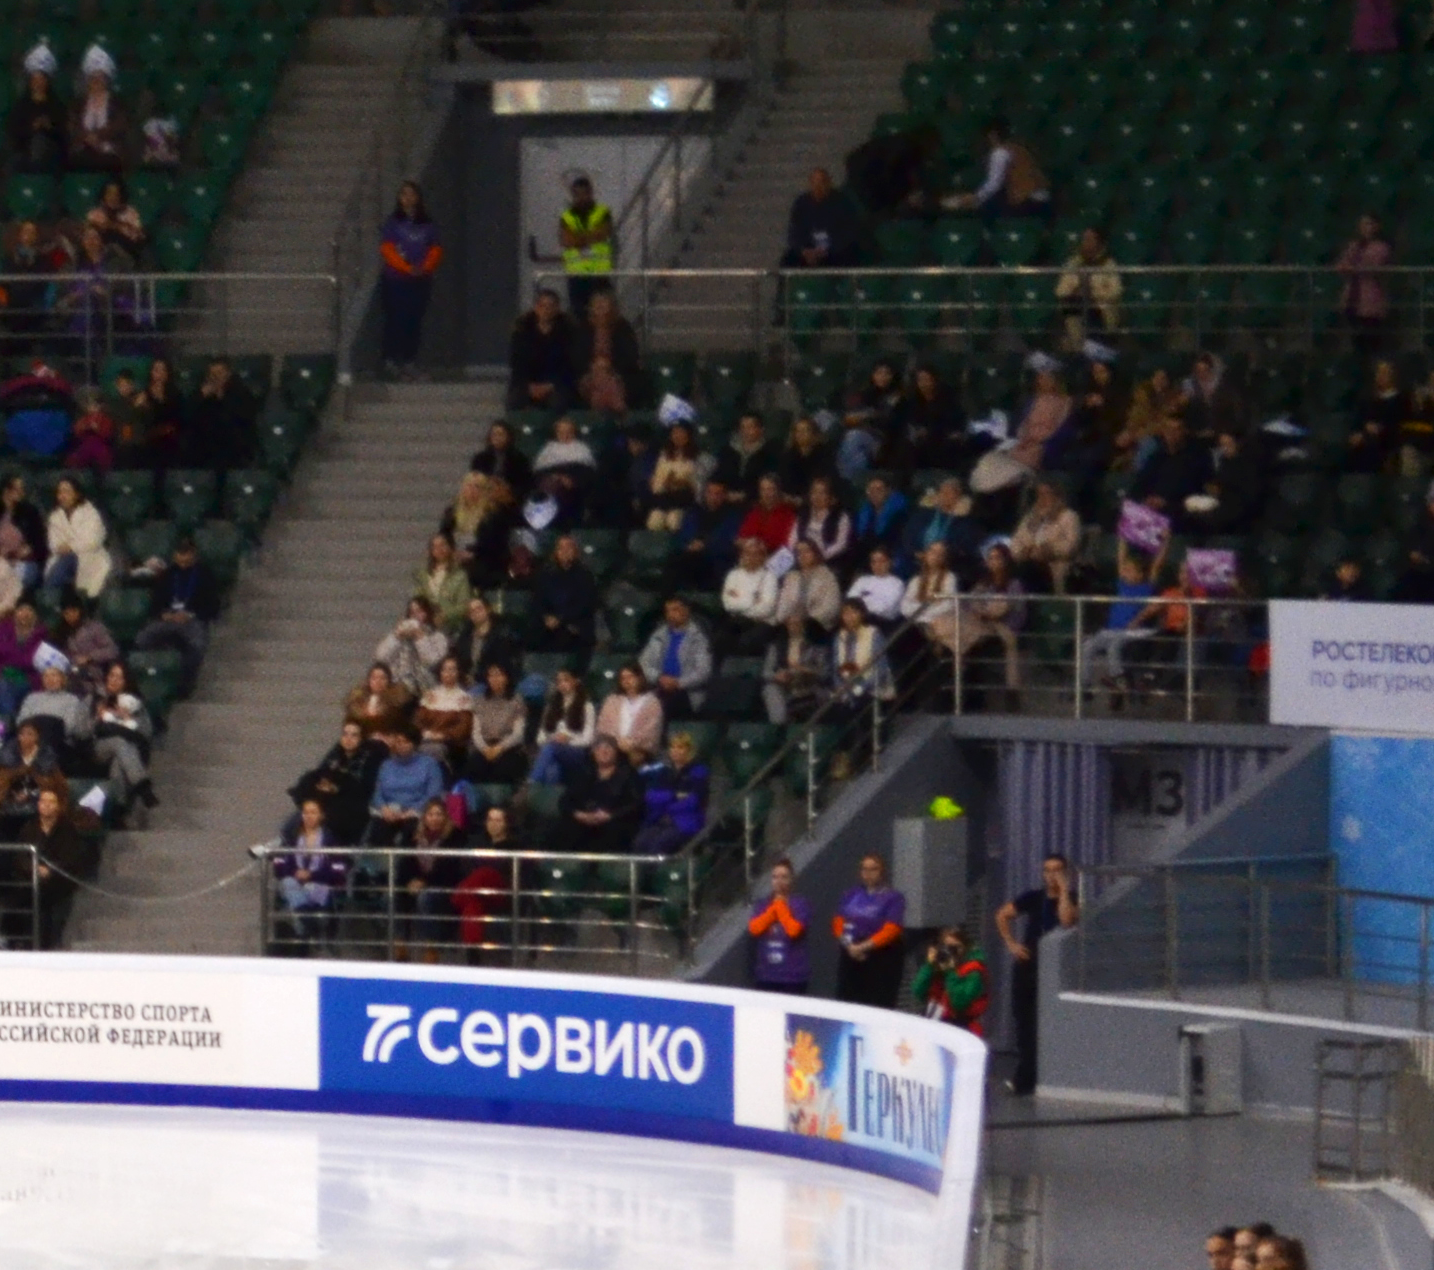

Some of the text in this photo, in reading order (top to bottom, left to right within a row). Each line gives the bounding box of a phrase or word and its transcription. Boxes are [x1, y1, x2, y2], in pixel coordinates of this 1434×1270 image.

[1312, 640, 1434, 665] РОСТЕЛЕКО
[1311, 671, 1335, 688] по
[140, 1004, 214, 1024] СПОРТА
[106, 1027, 223, 1050] ФЕДЕРАЦИИ
